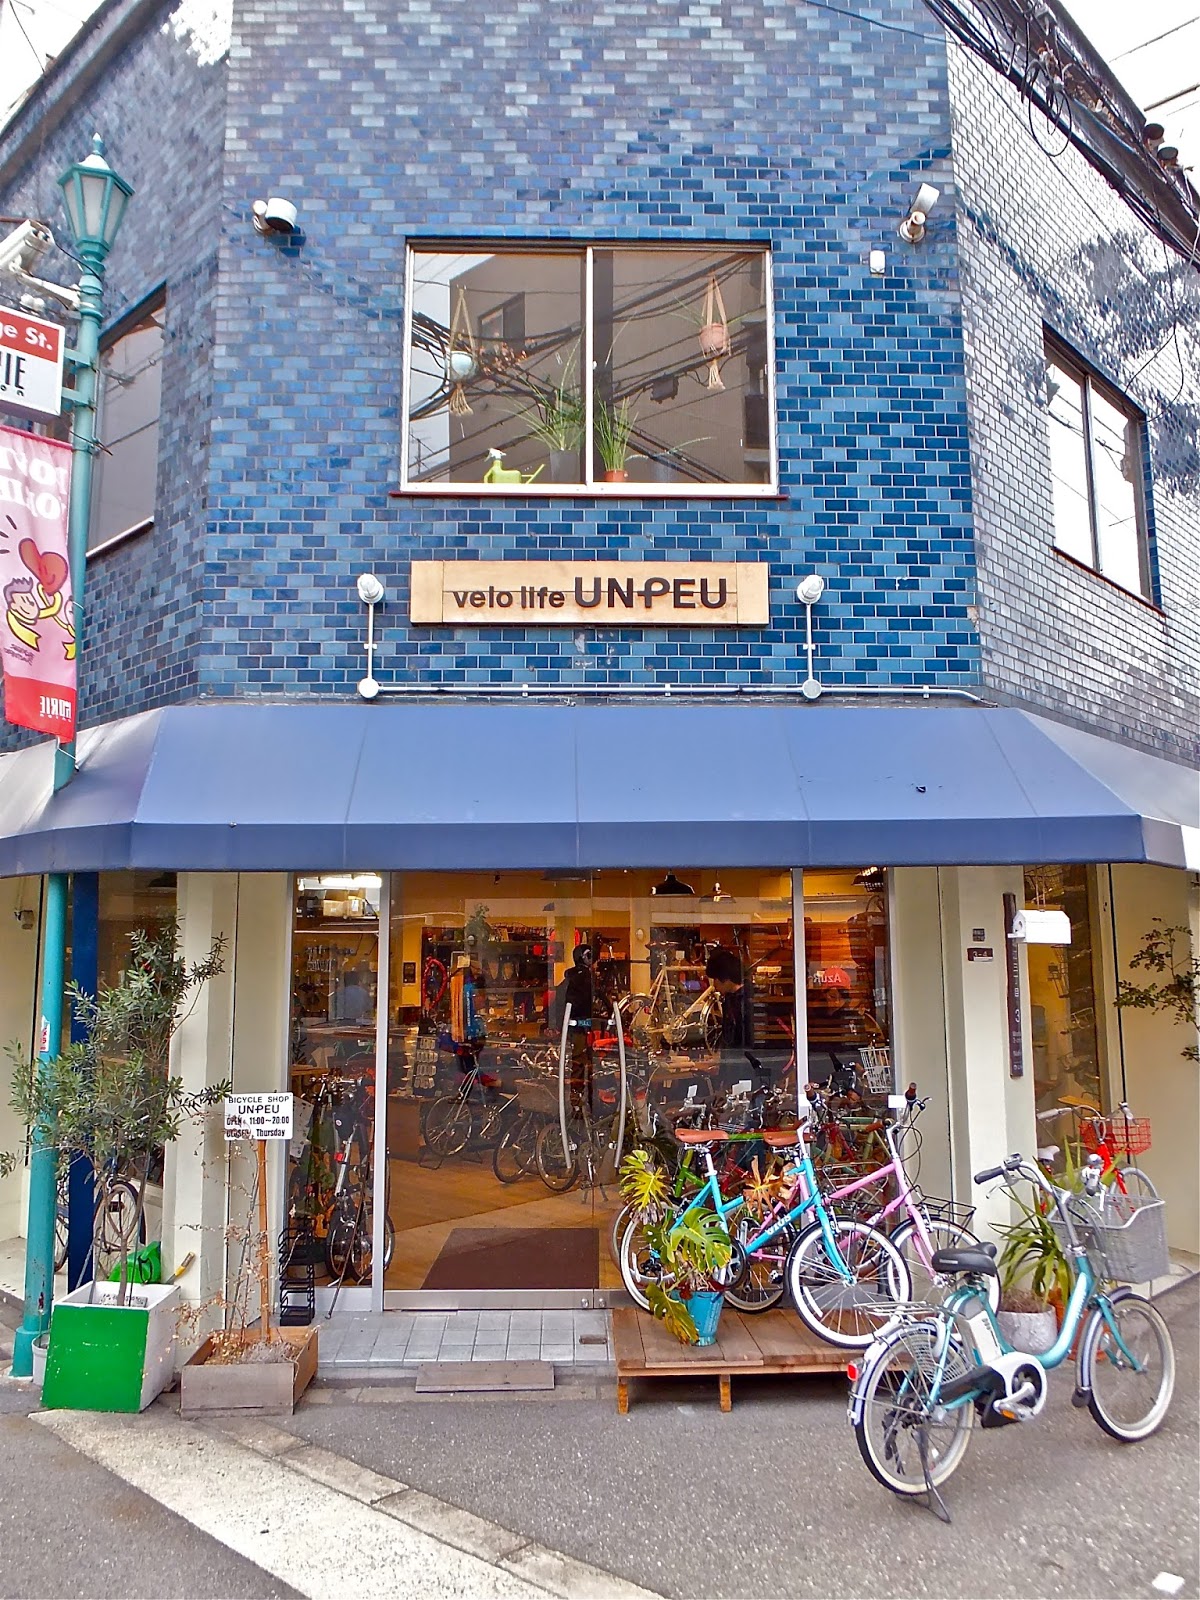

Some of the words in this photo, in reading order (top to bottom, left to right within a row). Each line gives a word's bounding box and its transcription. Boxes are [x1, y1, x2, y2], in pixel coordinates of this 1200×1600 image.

[25, 326, 53, 351] St.
[0, 351, 26, 390] IE
[453, 586, 513, 608] velo
[520, 585, 565, 609] life
[256, 1128, 285, 1137] Thursday
